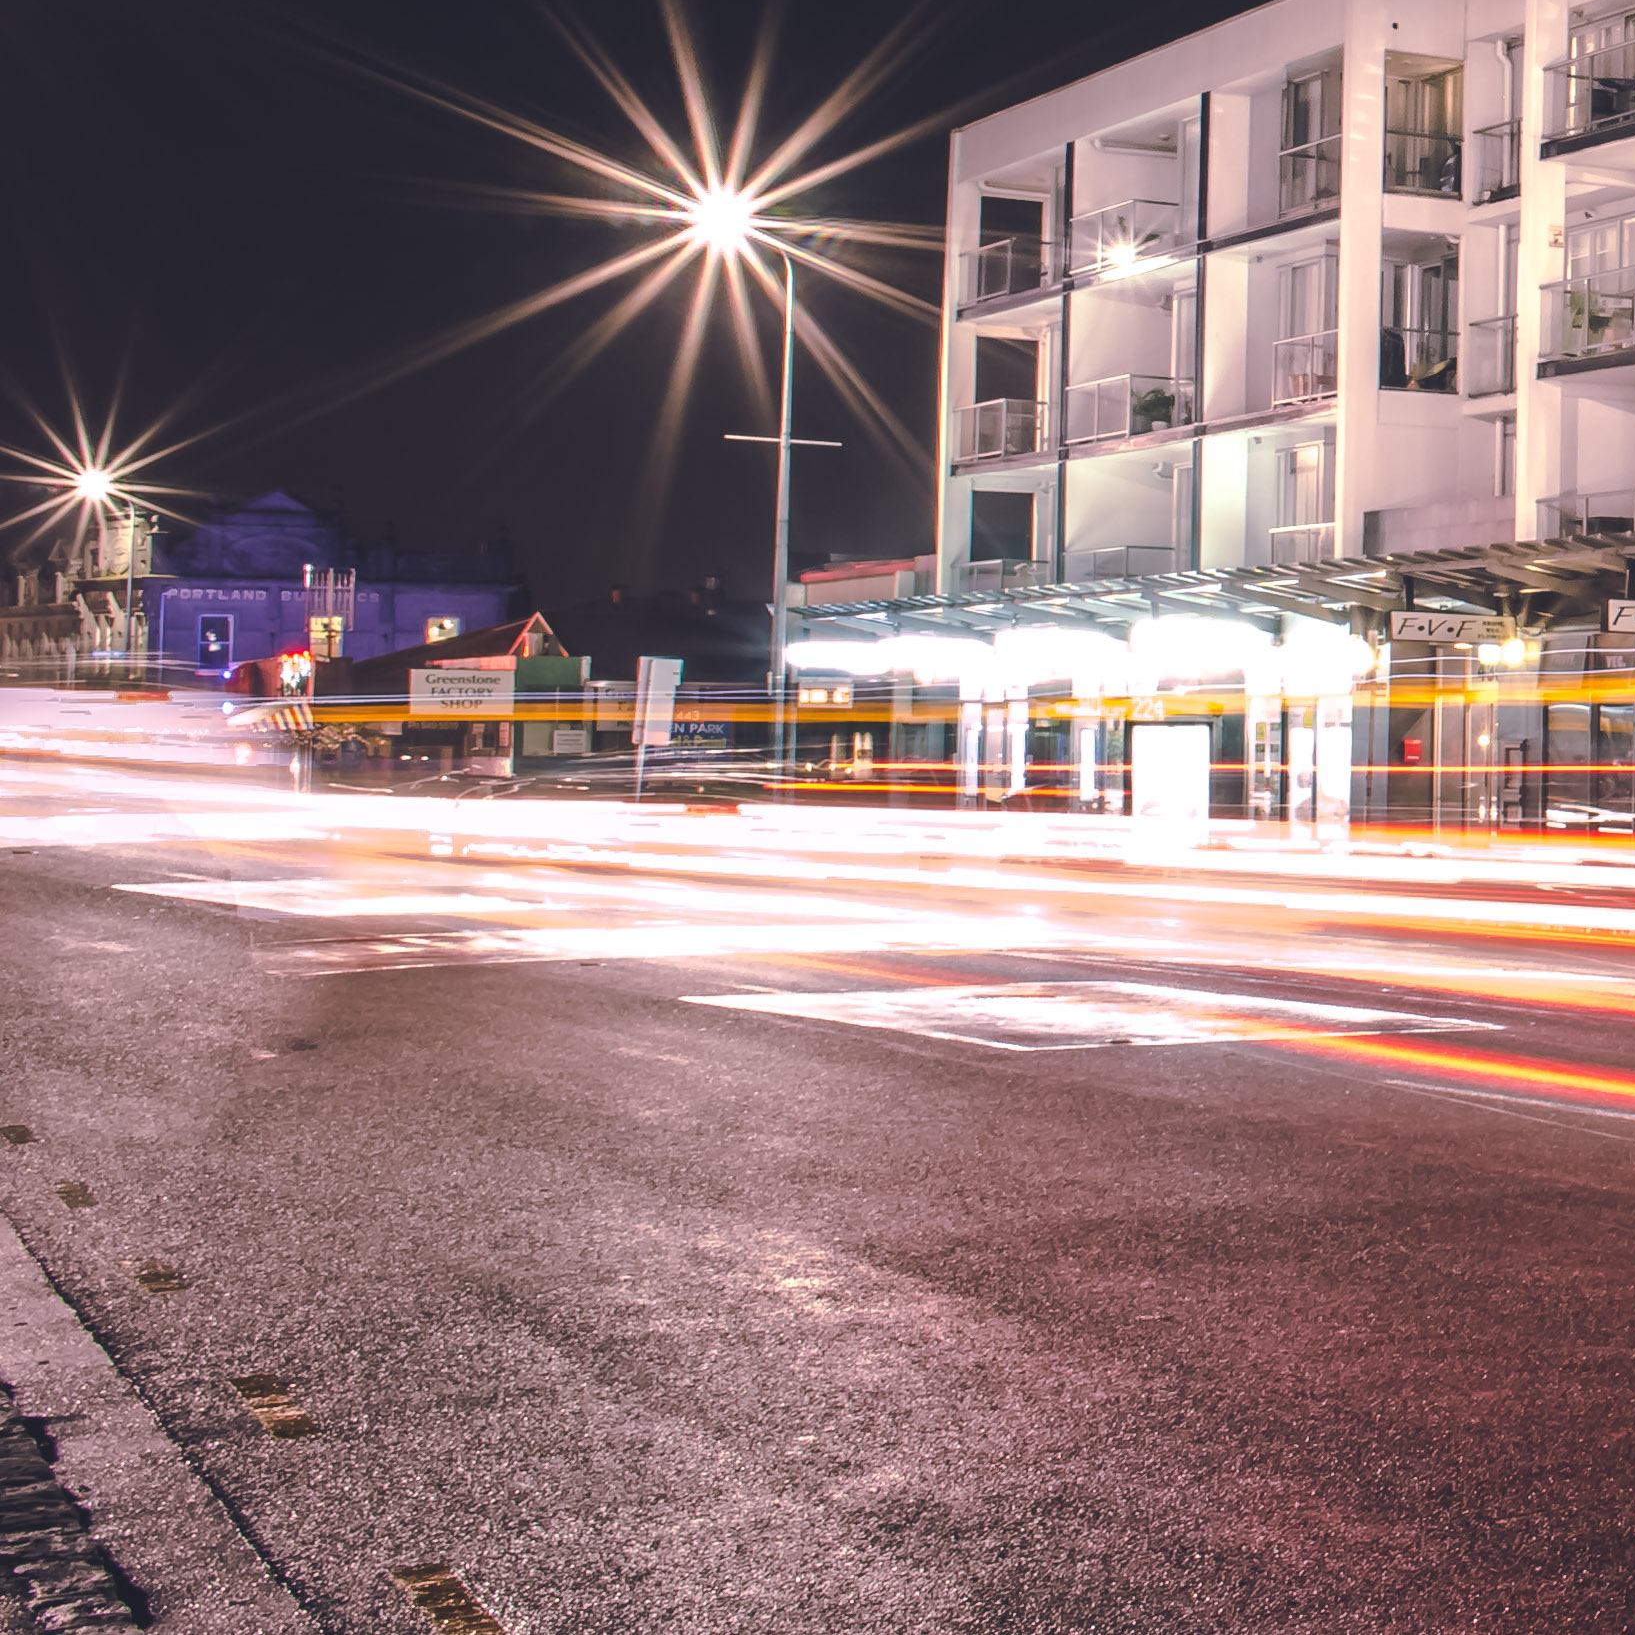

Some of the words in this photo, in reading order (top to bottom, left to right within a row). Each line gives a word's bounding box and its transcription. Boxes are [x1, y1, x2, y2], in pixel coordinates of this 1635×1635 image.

[166, 588, 267, 601] PORTLAND
[425, 673, 502, 685] Greenstone
[431, 686, 495, 697] FACTORY
[440, 699, 484, 709] SHOP
[677, 710, 700, 721] 443
[690, 723, 725, 734] PARK
